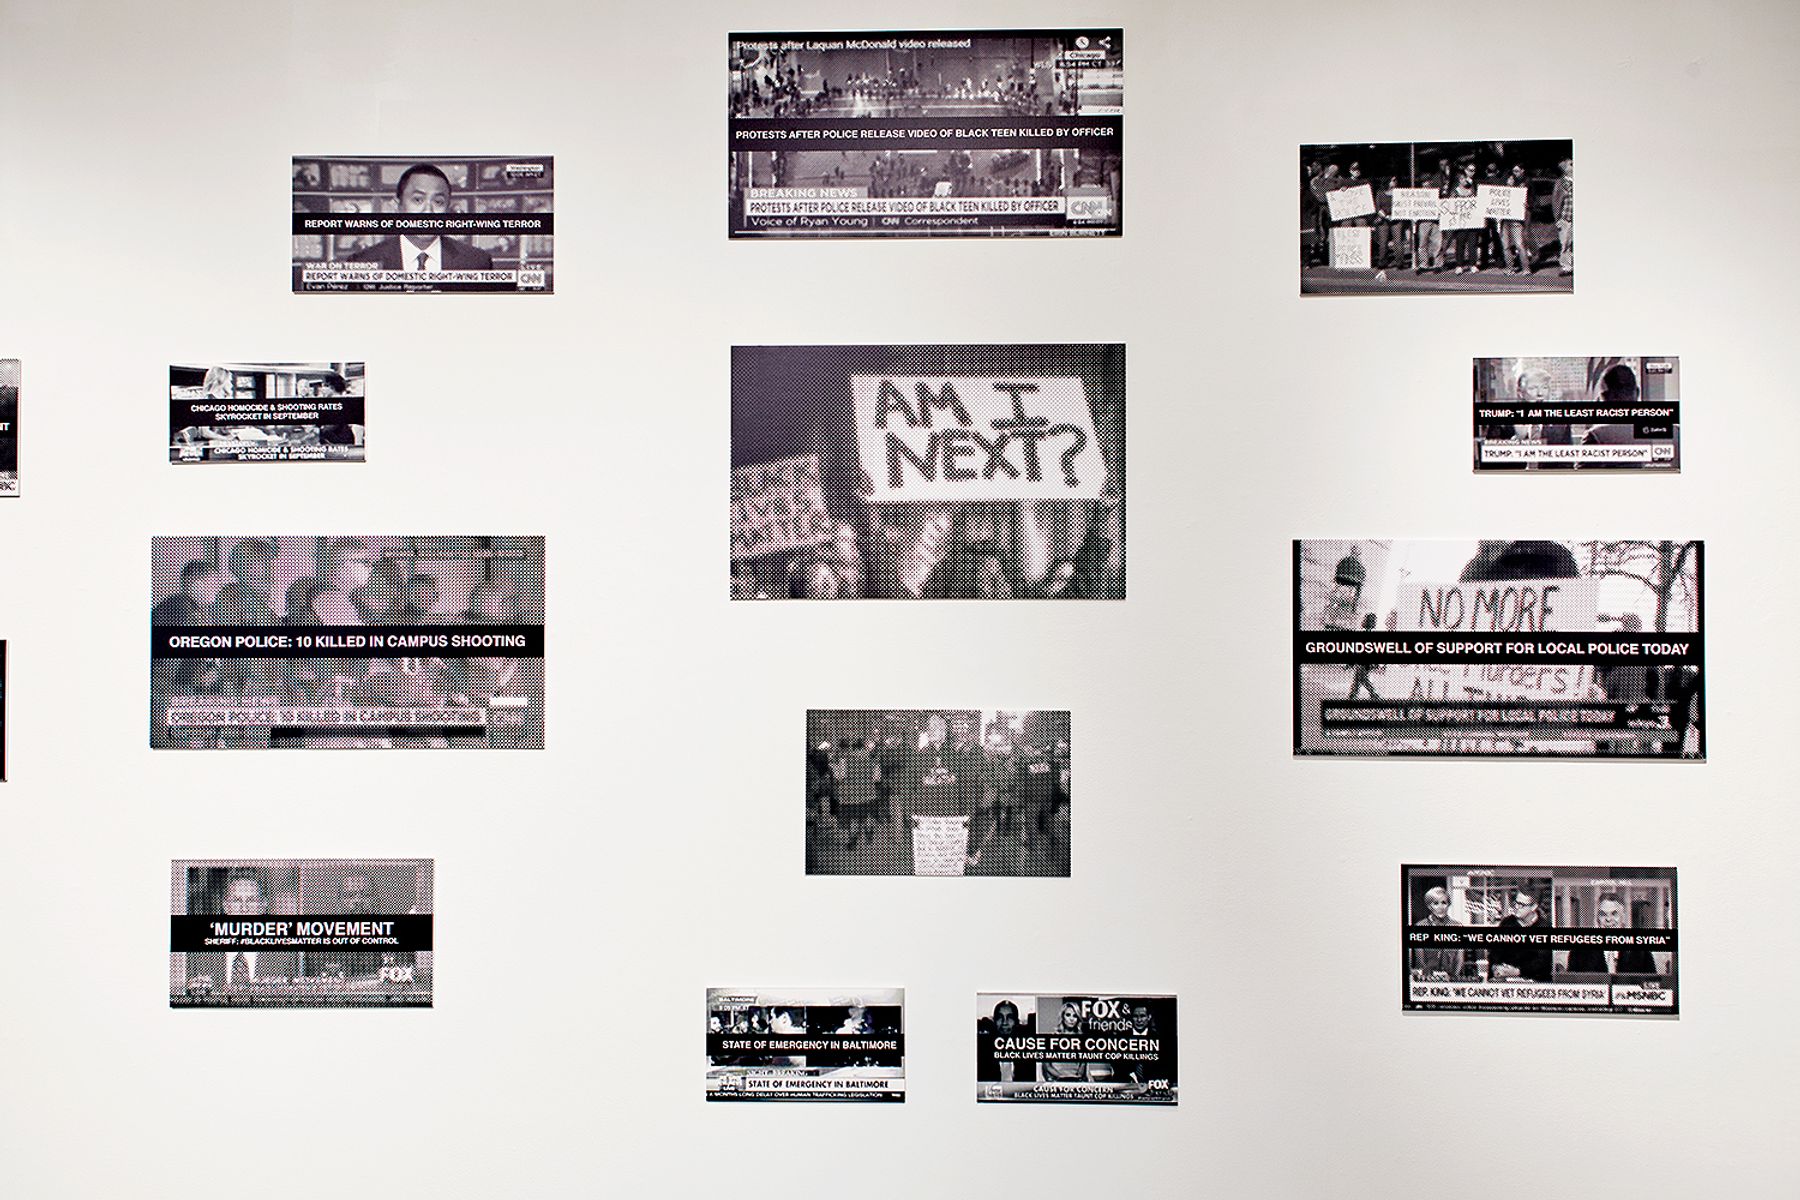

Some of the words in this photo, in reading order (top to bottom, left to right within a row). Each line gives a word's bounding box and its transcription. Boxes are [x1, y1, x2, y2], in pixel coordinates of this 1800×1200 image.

[737, 41, 778, 51] Protests
[781, 40, 804, 50] after
[807, 40, 843, 50] Laquan
[846, 40, 896, 50] McDonald
[899, 39, 925, 49] video
[928, 39, 971, 49] released
[736, 130, 787, 139] PROTESTS
[789, 130, 821, 139] AFTER
[823, 130, 858, 139] POLICE
[860, 129, 905, 138] RELEASE
[908, 129, 938, 138] VIDEO
[940, 129, 954, 138] OF
[956, 129, 989, 138] BLACK
[991, 128, 1017, 137] TEEN
[1019, 128, 1054, 137] KILLED
[1056, 128, 1069, 137] BY
[1072, 128, 1114, 137] OFFICER
[750, 188, 816, 198] BREAKING
[820, 188, 858, 198] NEWS
[750, 202, 791, 213] PROTESTS
[793, 202, 819, 213] AFTER
[821, 202, 850, 213] POLICE
[852, 201, 886, 212] RELEASE
[890, 201, 914, 212] VIDEO
[916, 201, 928, 212] OF
[930, 201, 957, 212] BLACK
[959, 201, 980, 212] TEEN
[982, 201, 1008, 212] KILLED
[1011, 201, 1021, 212] BY
[1024, 201, 1059, 212] OFFICER
[304, 220, 343, 228] REPORT
[344, 220, 380, 228] WARNS
[381, 220, 394, 228] OF
[396, 220, 444, 228] DOMESTIC
[446, 220, 500, 228] RIGHT-WING
[503, 220, 542, 228] TERROR
[752, 218, 783, 226] Voice
[786, 218, 798, 226] of
[801, 218, 828, 227] Ryan
[832, 218, 868, 227] Young
[904, 216, 978, 226] Correspondent
[306, 272, 338, 280] REPORT
[340, 272, 370, 280] WARNS
[372, 272, 383, 280] OF
[386, 272, 427, 280] DOMESTIC
[429, 272, 478, 280] RIGHT-WING
[480, 272, 513, 280] TERROR
[190, 404, 226, 412] CHICAGO
[874, 380, 974, 429] AM
[991, 381, 1049, 430] I
[214, 413, 262, 421] SKYROCKET
[263, 412, 272, 420] IN
[272, 412, 319, 420] SEPTEMBER
[1479, 409, 1514, 417] TRUMP:
[1528, 409, 1542, 417] AM
[1544, 409, 1563, 417] THE
[1564, 408, 1595, 417] LEAST
[1596, 408, 1630, 417] RACIST
[883, 422, 1087, 489] NEXT?
[1524, 450, 1537, 458] AM
[1538, 450, 1552, 458] THE
[1555, 450, 1580, 458] LEAST
[1582, 450, 1610, 458] RACIST
[1418, 586, 1465, 631] NO
[168, 635, 232, 649] OREGON
[235, 635, 294, 649] POLICE:
[296, 635, 312, 649] 10
[316, 635, 367, 649] KILLED
[369, 635, 384, 648] IN
[387, 635, 447, 648] CAMPUS
[450, 635, 526, 648] SHOOTING
[1306, 642, 1412, 655] GROUNDSWELL
[1414, 642, 1434, 655] OF
[1436, 643, 1502, 655] SUPPORT
[1506, 643, 1535, 655] FOR
[1538, 643, 1585, 655] LOCAL
[1588, 643, 1640, 656] POLICE
[1643, 643, 1690, 656] TODAY
[296, 922, 395, 936] MOVEMENT
[1434, 933, 1461, 942] KING:
[1486, 934, 1526, 943] CANNOT
[1529, 934, 1548, 943] VET
[1550, 935, 1603, 944] REFUGEES
[1605, 935, 1635, 944] FROM
[1468, 987, 1499, 998] CANNOT
[1502, 987, 1515, 998] VET
[1517, 988, 1556, 998] REFUGEES
[1558, 988, 1580, 999] FROM
[1081, 1000, 1120, 1018] FOX
[1122, 1004, 1131, 1014] &
[1088, 1018, 1133, 1031] friends
[722, 1041, 752, 1050] STATE
[754, 1041, 766, 1050] OF
[769, 1041, 828, 1050] EMERGENCY
[830, 1041, 840, 1050] IN
[843, 1041, 897, 1050] BALTIMORE
[994, 1038, 1046, 1051] CAUSE
[1050, 1038, 1081, 1051] FOR
[1085, 1039, 1160, 1051] CONCERN
[994, 1052, 1021, 1060] BLACK
[1022, 1052, 1044, 1060] LIVES
[1046, 1052, 1077, 1060] MATTER
[1079, 1053, 1104, 1061] TAUNT
[1105, 1053, 1122, 1061] COP
[1123, 1053, 1159, 1061] KILLINGS
[748, 1080, 770, 1088] STATE
[772, 1080, 784, 1088] OF
[786, 1080, 832, 1088] EMERGENCY
[834, 1080, 844, 1088] IN
[846, 1080, 889, 1088] BALTIMORE
[1148, 1080, 1168, 1089] FOX
